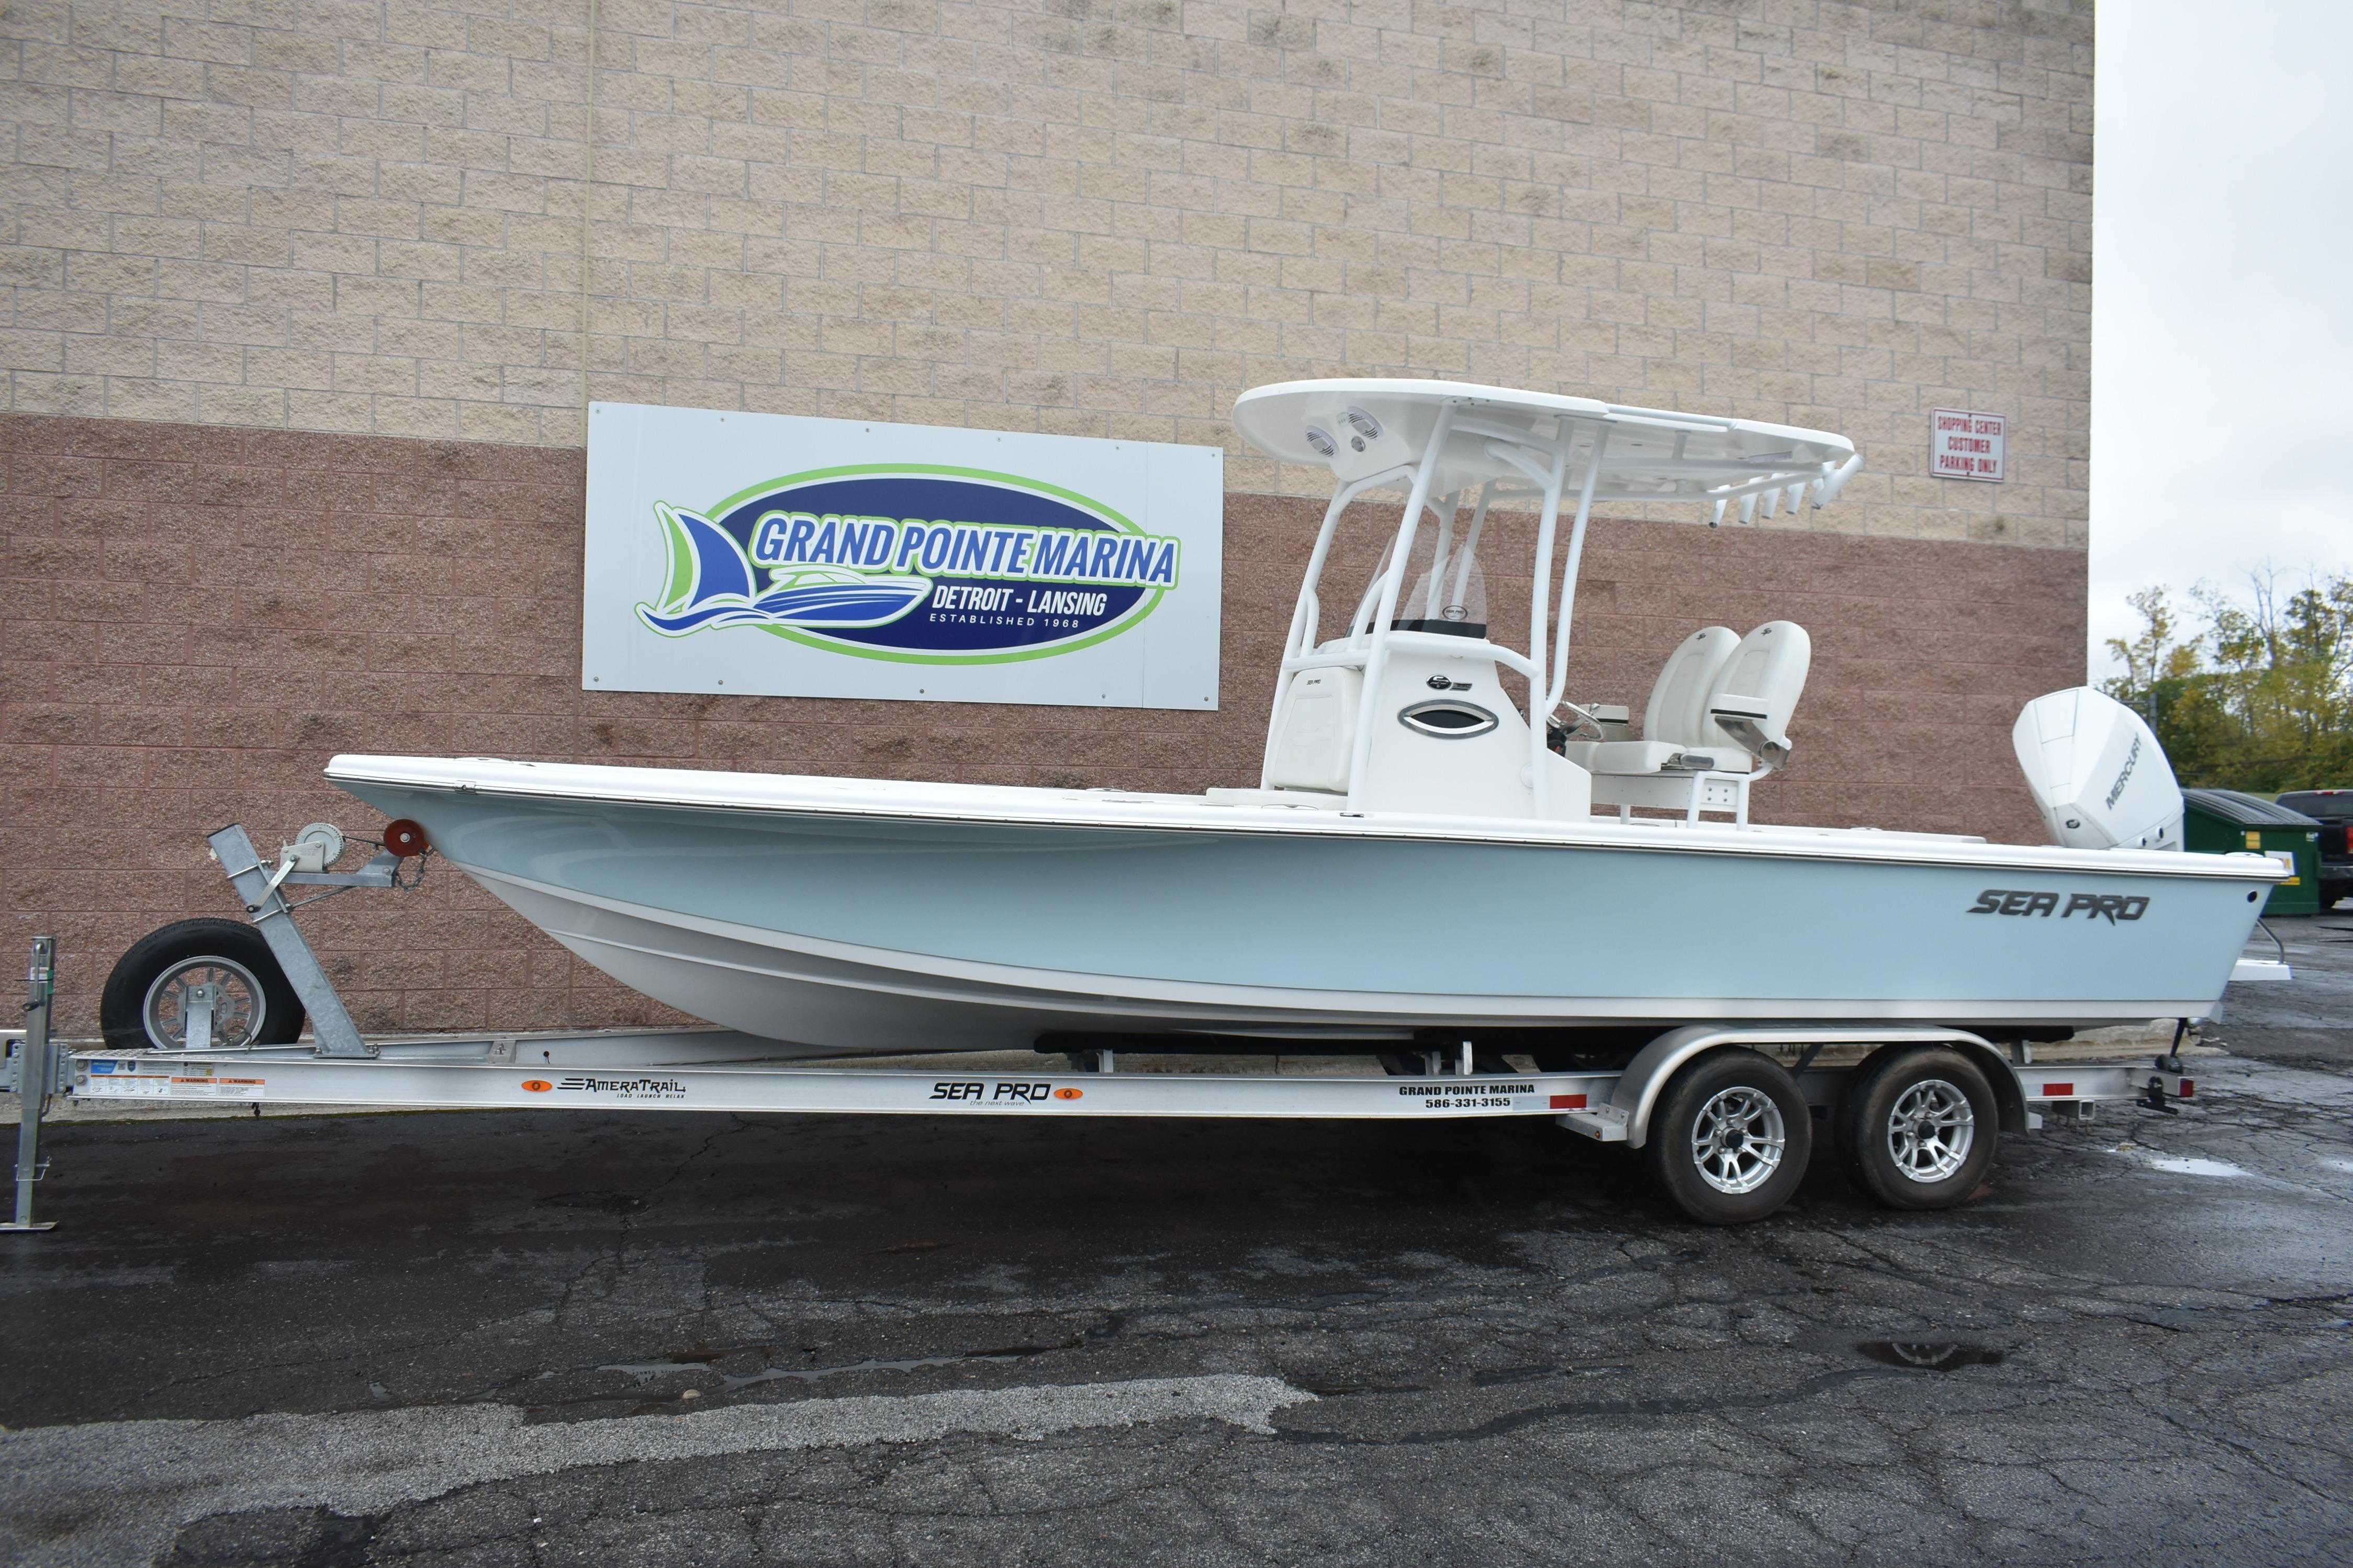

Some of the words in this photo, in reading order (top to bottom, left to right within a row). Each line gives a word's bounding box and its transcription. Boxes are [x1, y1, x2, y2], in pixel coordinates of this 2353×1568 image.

[1938, 416, 1972, 433] SHIPPING
[1976, 420, 2002, 435] CENTER
[1948, 436, 1991, 454] CUSTOMER
[1940, 455, 1975, 471] PARKING
[1978, 458, 1998, 473] ONLY
[756, 517, 894, 566] GRAND
[896, 526, 1034, 574] POINTE
[1032, 534, 1174, 583] MARINA
[932, 585, 1014, 612] DETROIT
[1026, 590, 1107, 616] LANSING
[929, 613, 1035, 626] ESTABLISHED
[1044, 618, 1079, 628] 1968
[2105, 731, 2142, 811] MERCURY
[1966, 889, 2059, 917] SEA
[2060, 893, 2150, 926] PRO
[928, 1082, 984, 1100] SEA
[992, 1083, 1051, 1105] PRO
[1399, 1086, 1441, 1096] GRAND
[1444, 1085, 1487, 1095] POINTE
[1489, 1084, 1535, 1095] MARINA
[1425, 1097, 1511, 1109] 586-331-3155
